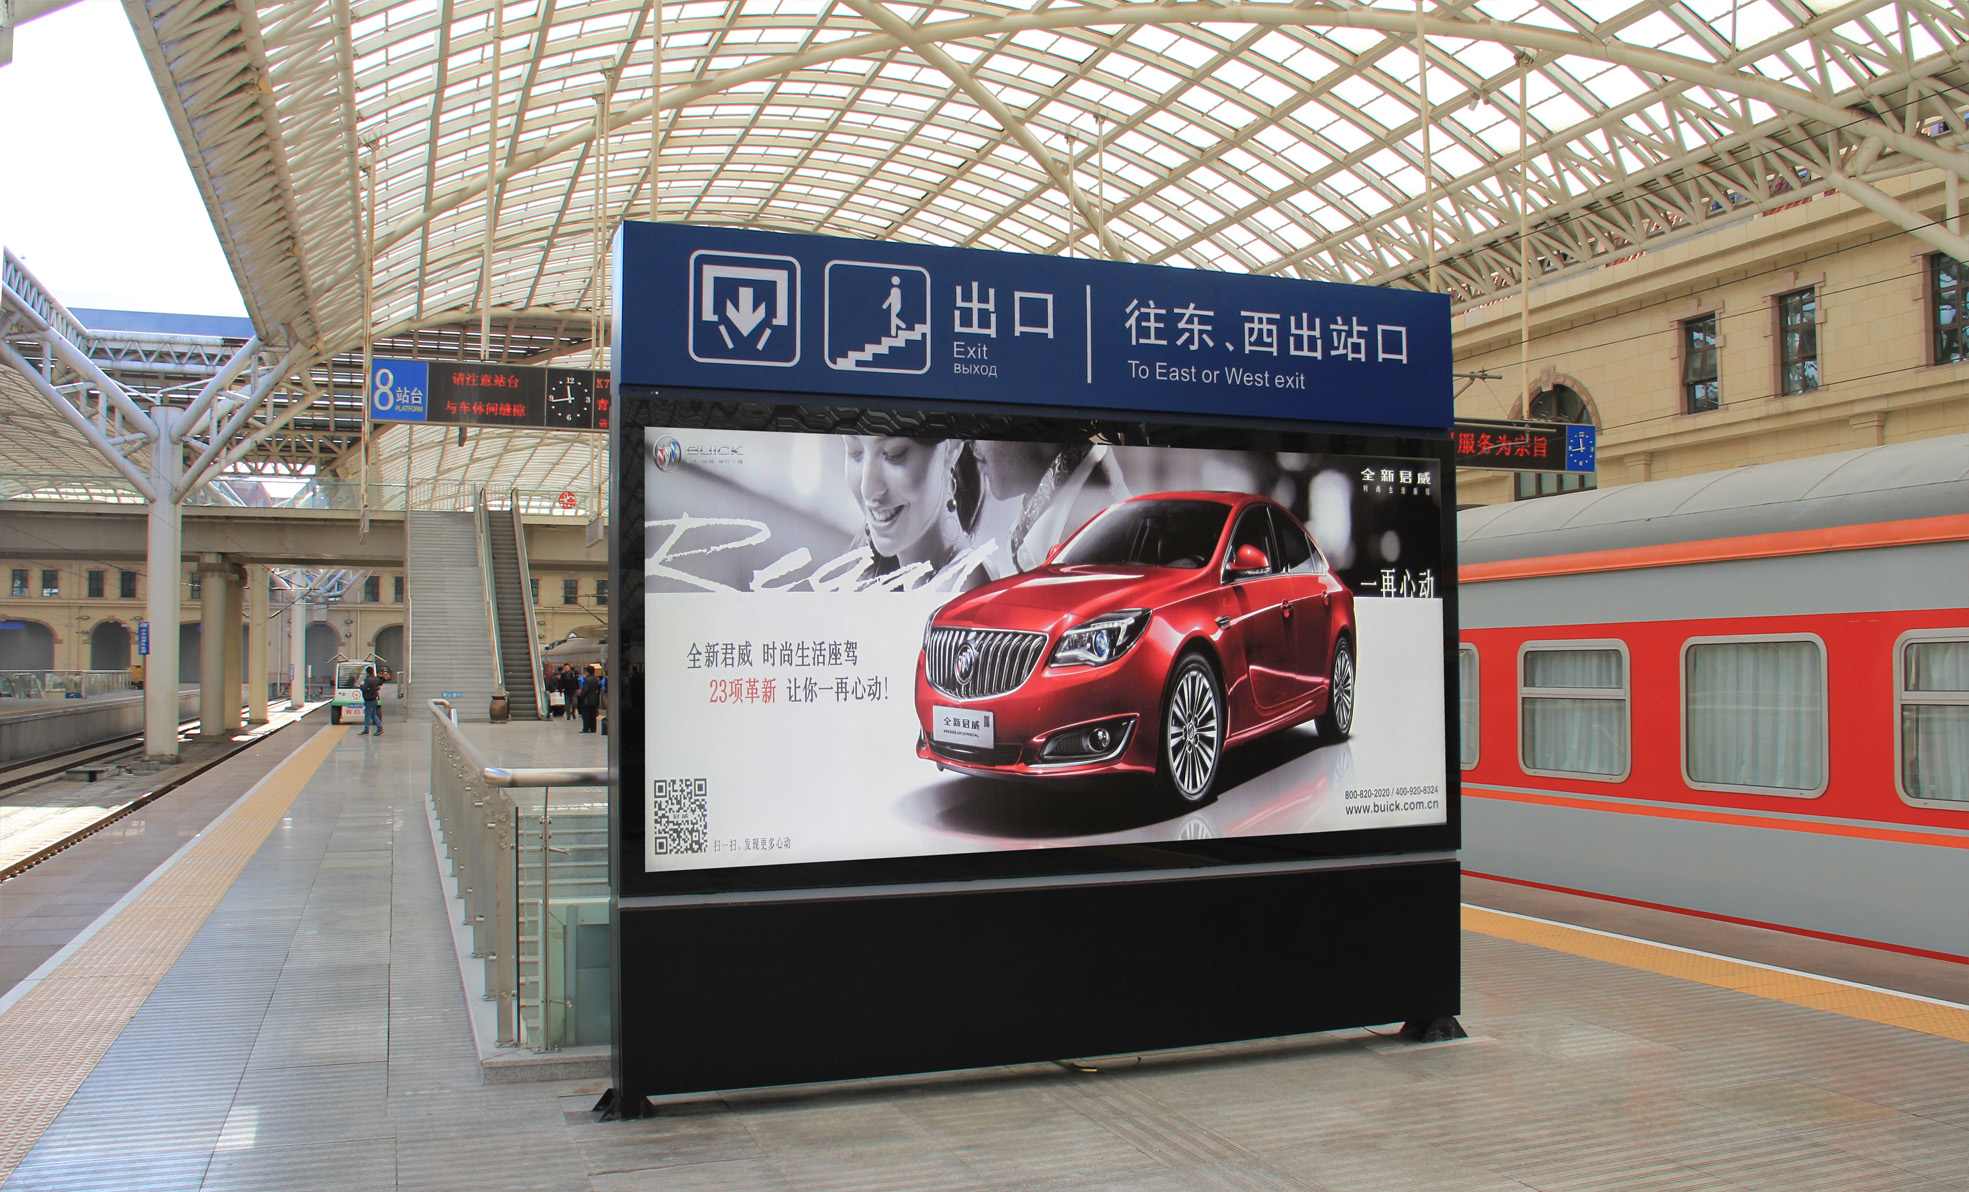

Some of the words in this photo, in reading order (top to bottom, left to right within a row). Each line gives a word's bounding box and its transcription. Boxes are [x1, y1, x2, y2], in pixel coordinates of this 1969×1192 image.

[953, 280, 1054, 339] 出口
[1124, 298, 1408, 364] 往东、西出站口
[953, 341, 988, 360] Exit
[452, 372, 520, 389] 请注意站台
[953, 363, 998, 378] выход
[1127, 360, 1149, 379] To
[1155, 362, 1197, 382] East
[1201, 369, 1220, 384] or
[1224, 367, 1270, 387] West
[1274, 372, 1306, 390] exit
[374, 368, 394, 411] 8
[395, 386, 423, 405] 站台
[686, 445, 744, 456] BUICK
[1450, 432, 1548, 458] 服务为宗旨
[1360, 467, 1432, 485] 全新君威
[1360, 568, 1434, 598] 一再心动
[686, 640, 753, 669] 全新君威
[762, 639, 858, 668] 时尚生活座驾
[709, 677, 777, 704] 23项革新
[1344, 788, 1390, 800] 800-820-2020
[1345, 799, 1439, 815] www.buick.com.cn
